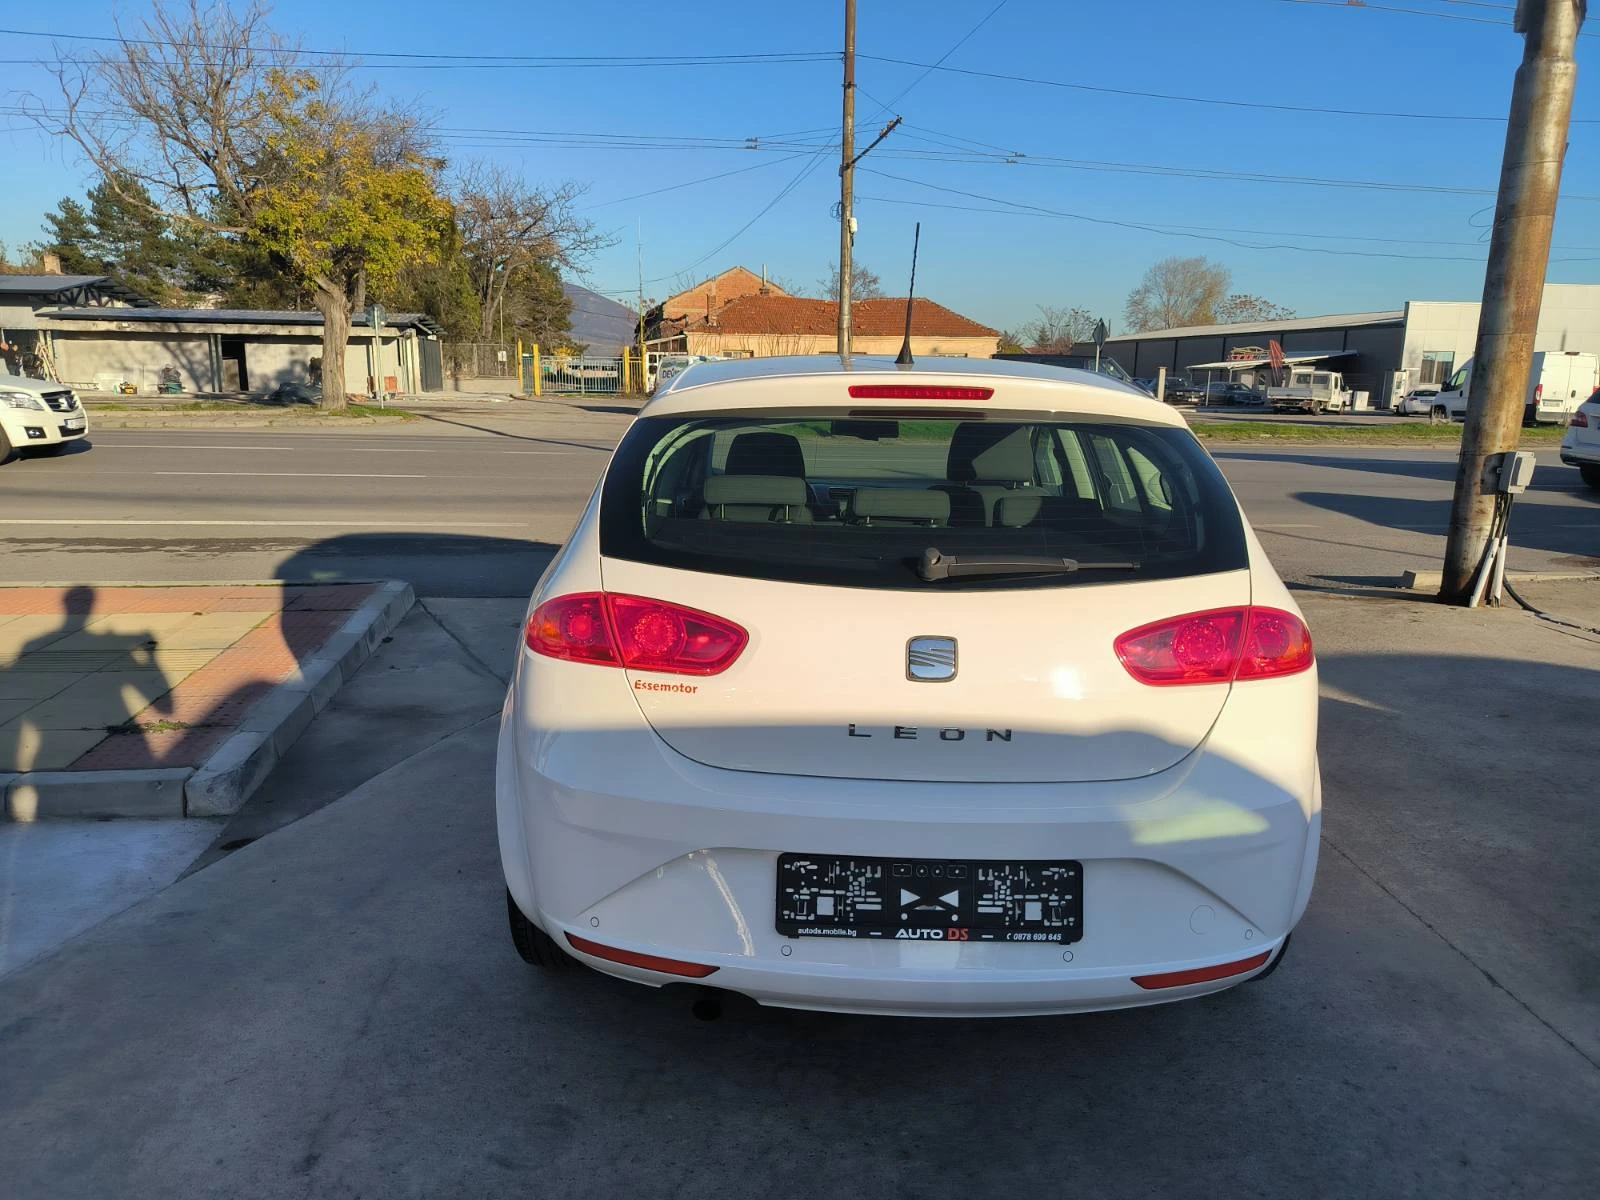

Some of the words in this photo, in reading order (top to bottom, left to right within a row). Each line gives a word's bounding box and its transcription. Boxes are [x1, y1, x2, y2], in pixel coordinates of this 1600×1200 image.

[634, 679, 698, 694] Essemotor
[848, 723, 1012, 742] LEON
[797, 927, 857, 937] autods.mobile.bg
[895, 928, 944, 939] AUTO
[947, 927, 969, 940] DS
[1013, 933, 1031, 941] 0878
